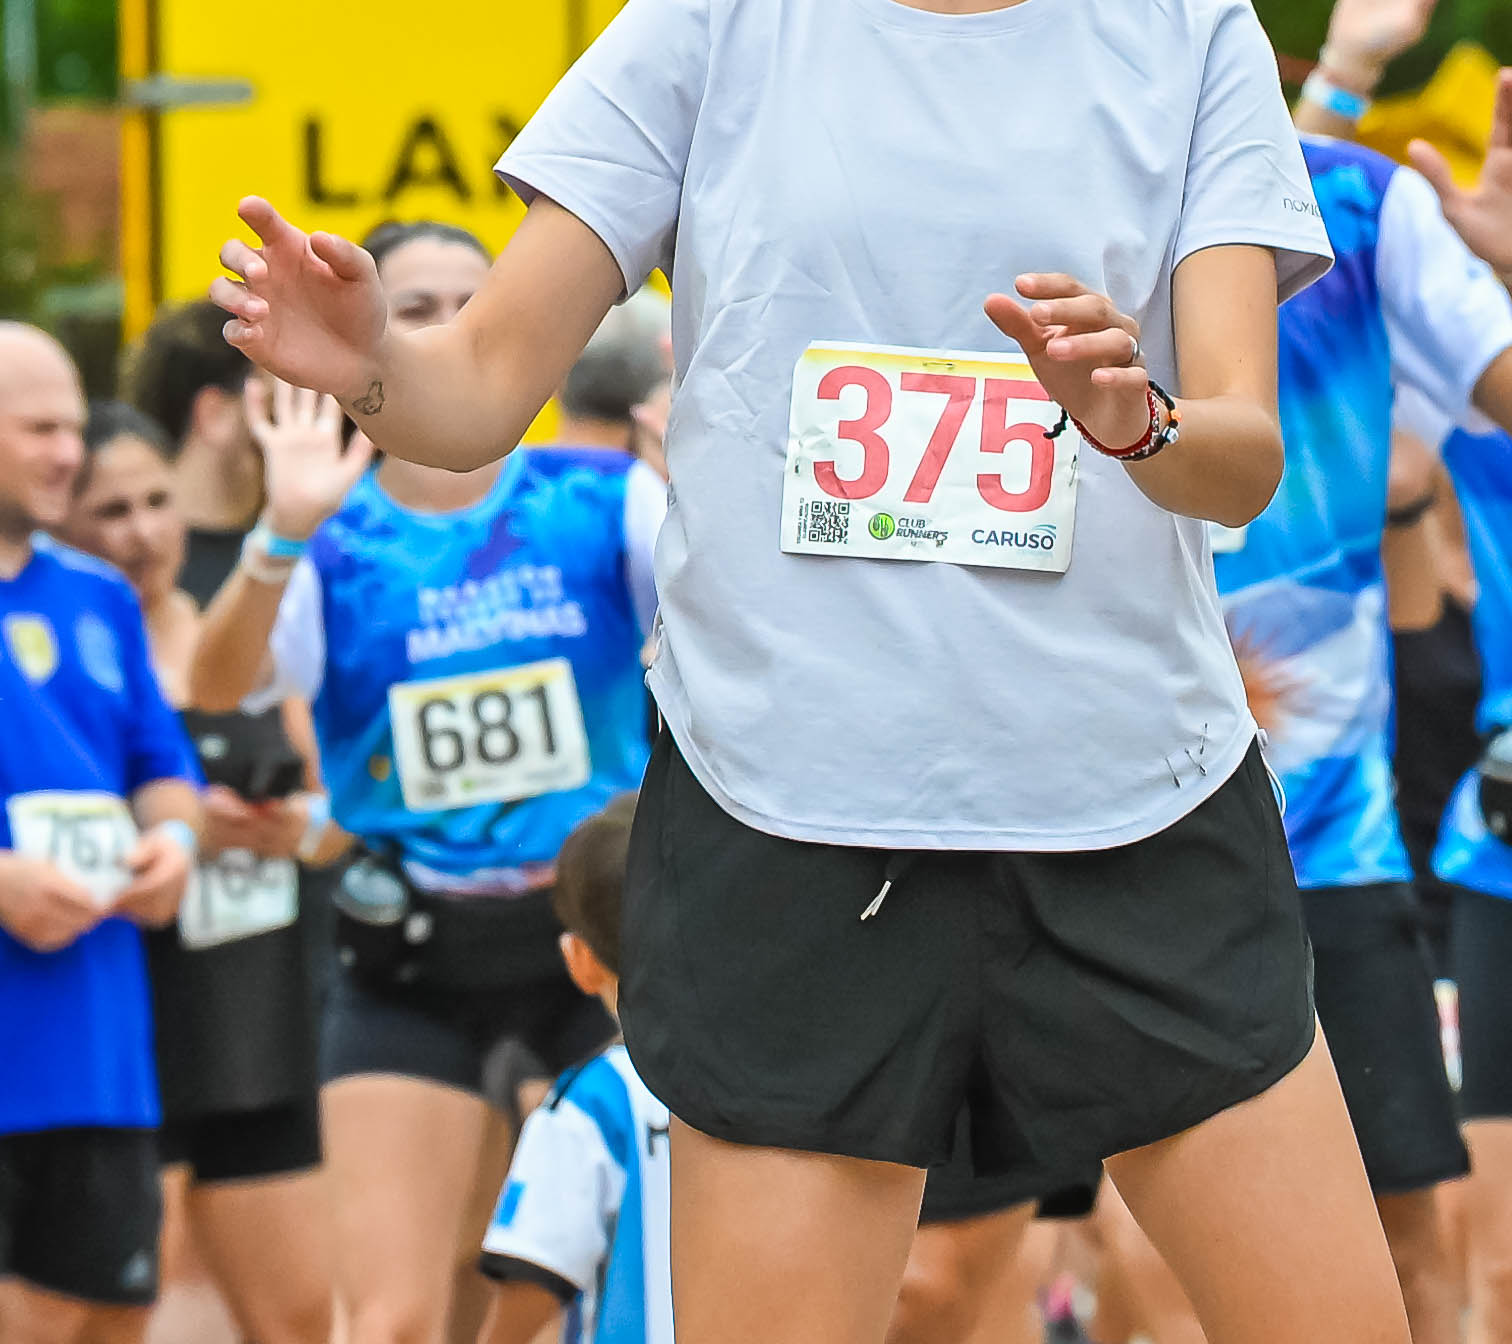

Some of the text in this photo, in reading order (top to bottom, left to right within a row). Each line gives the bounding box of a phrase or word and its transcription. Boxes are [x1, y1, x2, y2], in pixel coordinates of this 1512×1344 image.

[301, 115, 519, 205] LA
[813, 365, 1055, 513] 375
[898, 517, 926, 529] CLUB
[971, 529, 1055, 551] CARUSO
[418, 682, 557, 773] 681
